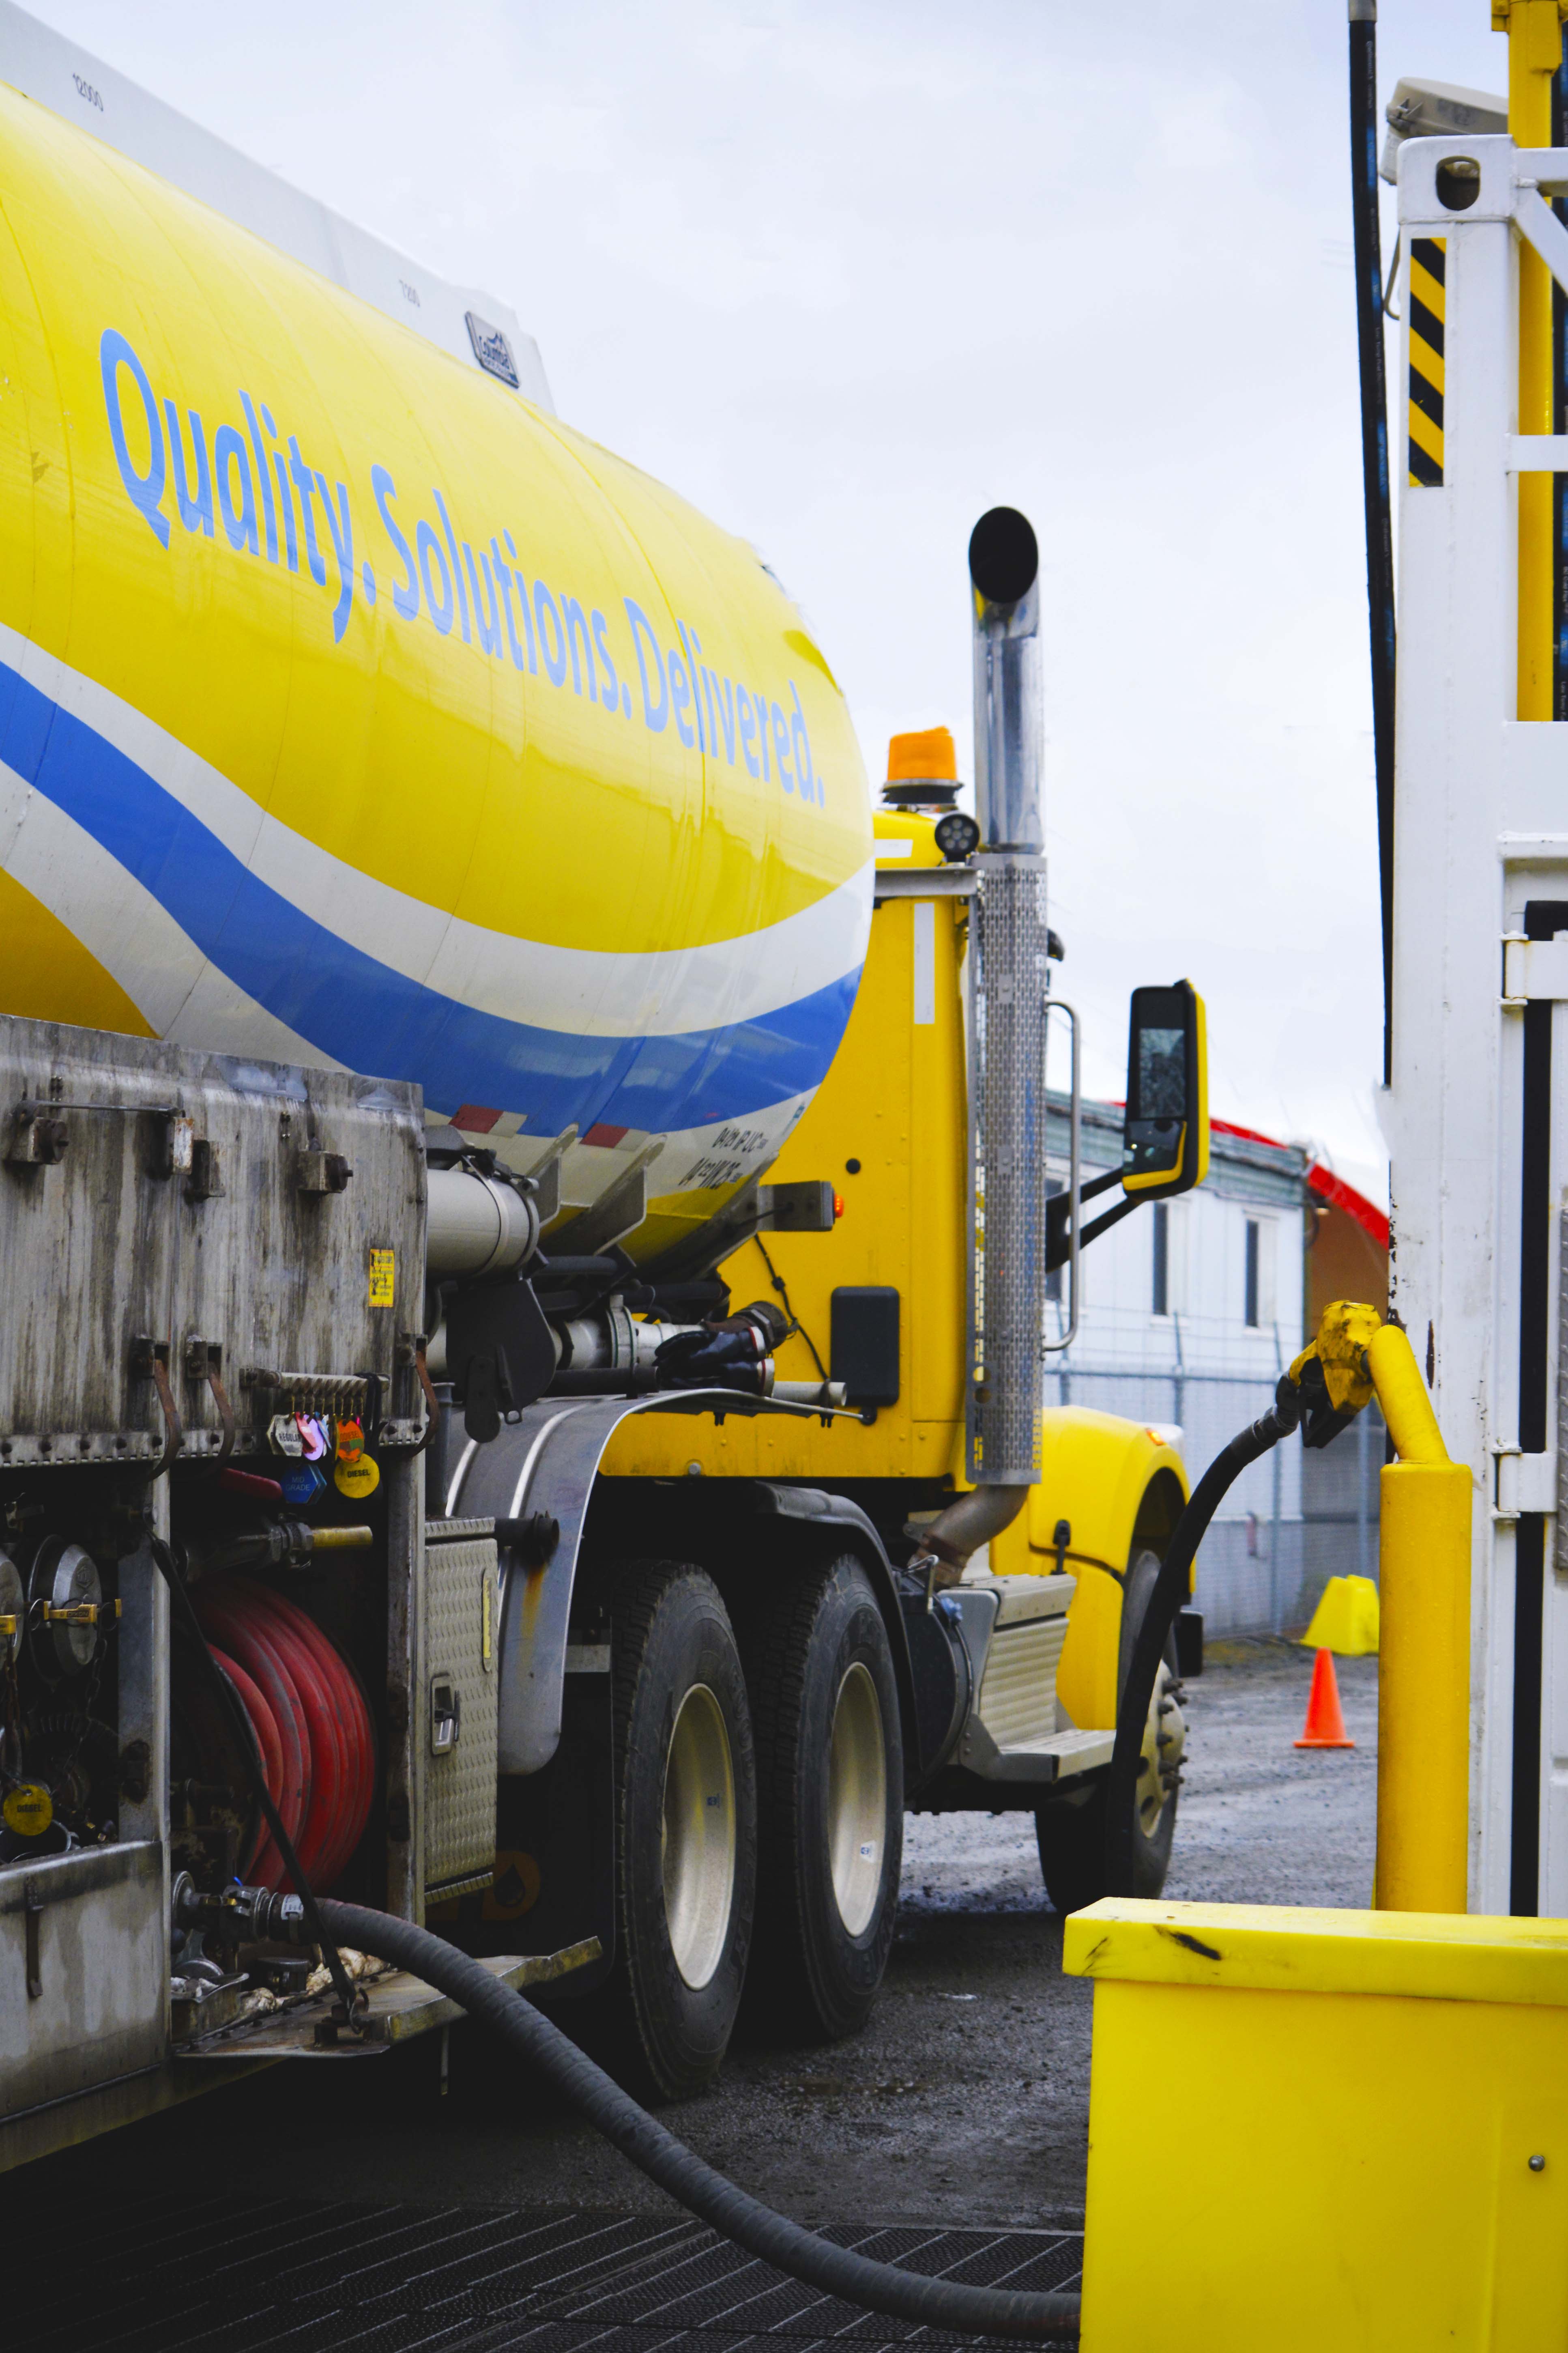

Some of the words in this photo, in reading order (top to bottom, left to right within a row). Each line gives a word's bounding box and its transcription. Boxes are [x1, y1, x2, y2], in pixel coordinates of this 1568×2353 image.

[100, 328, 377, 644] Quality.
[371, 463, 632, 721] Solutions.
[623, 596, 825, 809] Delivered.
[347, 1469, 370, 1478] DIESEL
[286, 1484, 311, 1492] GRADE
[17, 1804, 43, 1813] DIESEL
